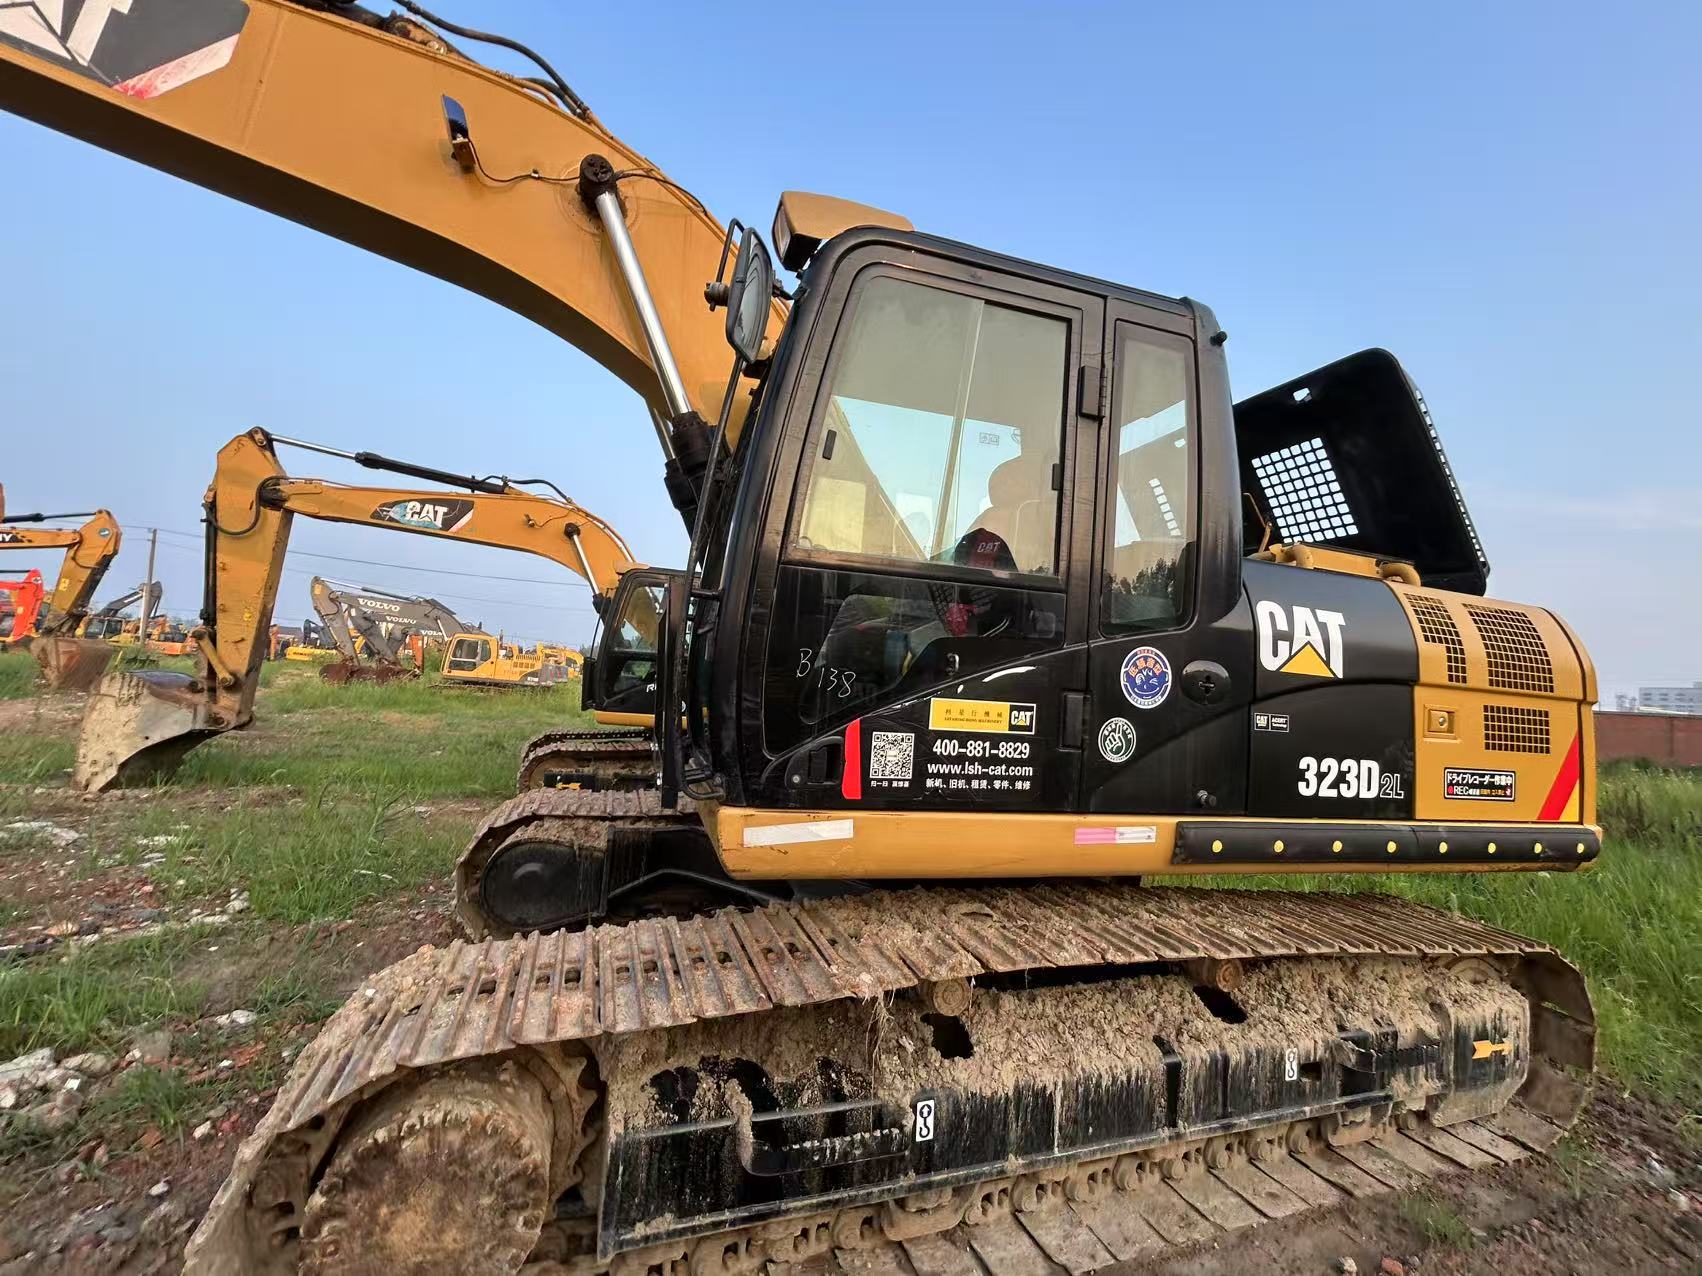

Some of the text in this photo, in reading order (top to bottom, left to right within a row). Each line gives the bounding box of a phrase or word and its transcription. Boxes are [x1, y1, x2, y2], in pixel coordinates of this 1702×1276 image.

[405, 501, 448, 528] CAT
[977, 541, 1000, 553] CAT
[358, 598, 400, 612] VOLVO
[386, 615, 416, 625] VOLVO
[1256, 600, 1346, 678] CAT
[796, 648, 856, 697] B 138
[1010, 710, 1034, 726] CAT
[1256, 715, 1268, 724] CAT
[932, 739, 1030, 759] 400-881-8829
[927, 761, 1033, 776] www.lsh-cat.com
[1453, 785, 1469, 795] REC
